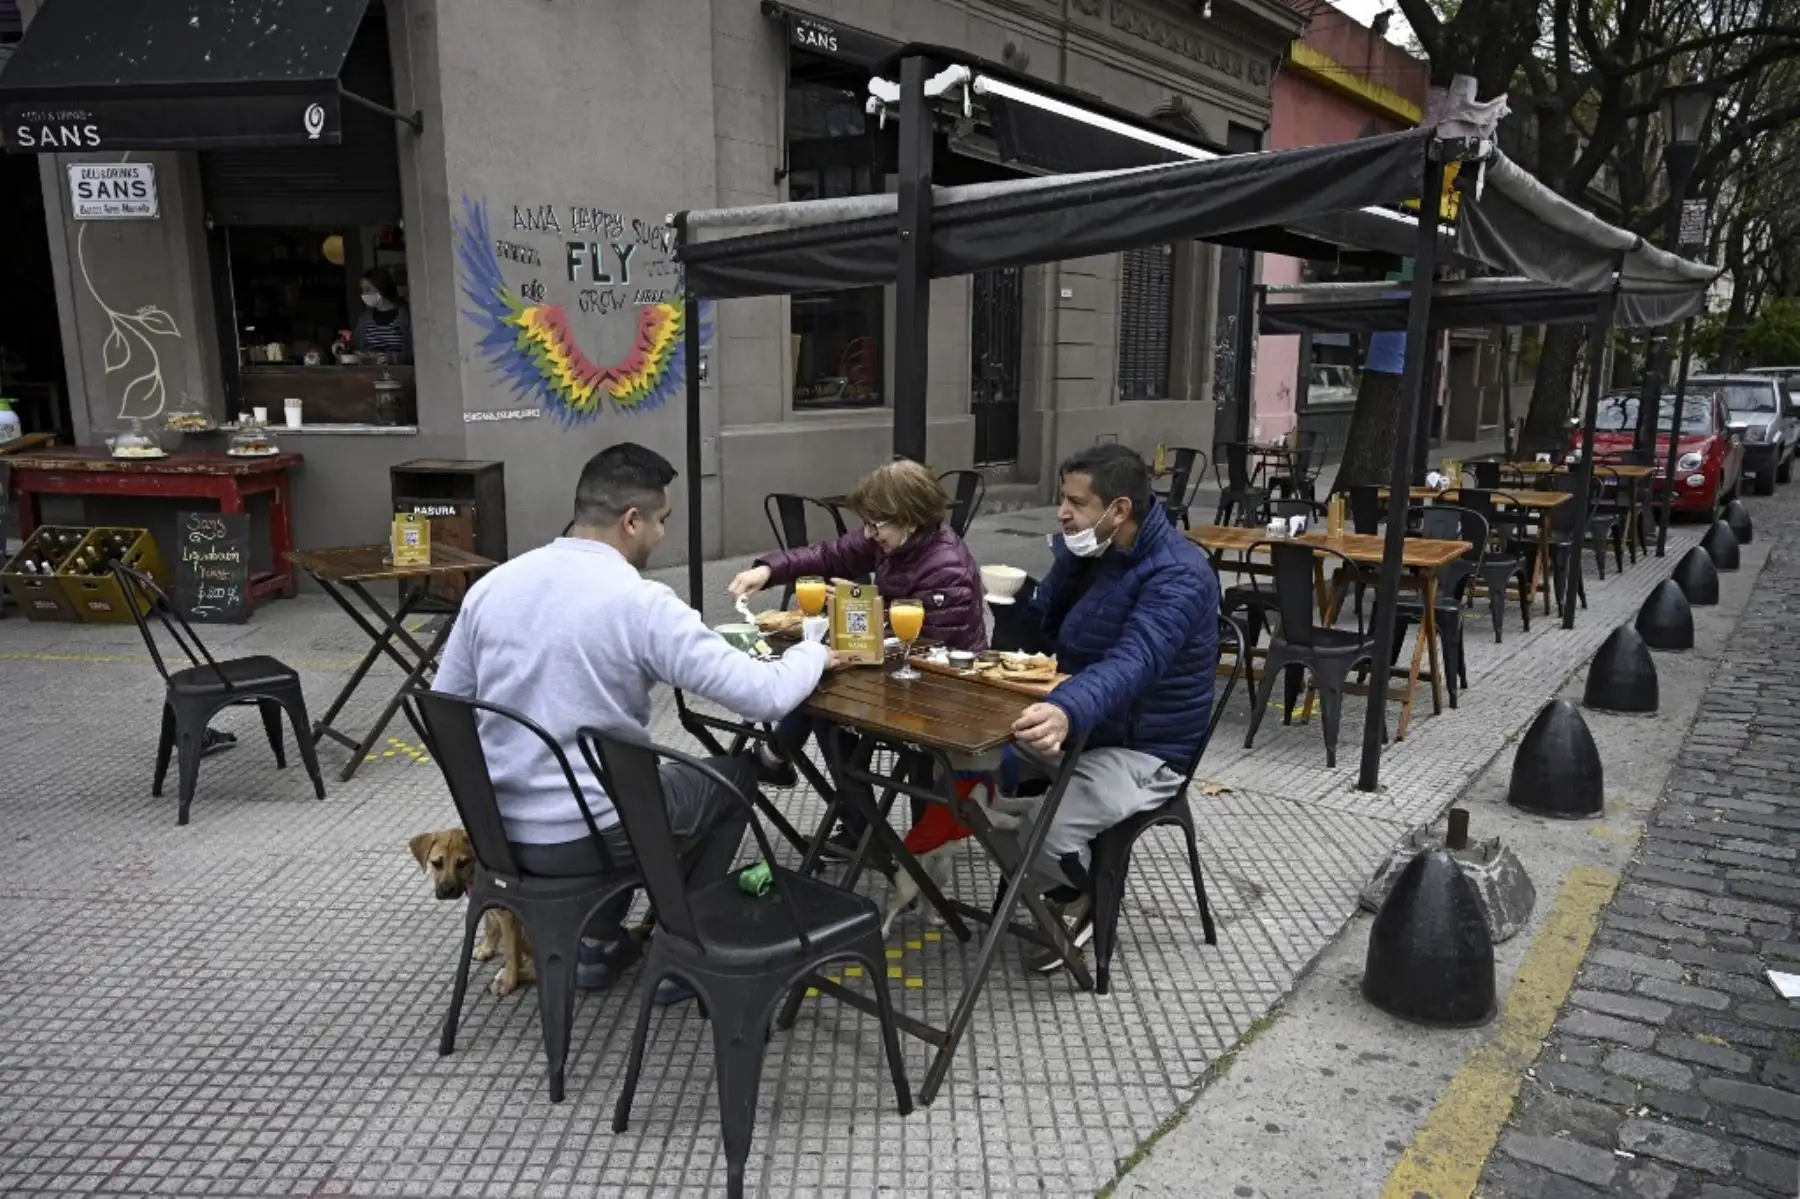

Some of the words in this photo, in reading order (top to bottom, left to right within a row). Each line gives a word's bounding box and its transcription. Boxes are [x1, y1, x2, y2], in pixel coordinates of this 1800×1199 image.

[796, 26, 838, 52] SANS
[17, 125, 101, 147] SANS
[78, 180, 147, 199] SANS
[566, 241, 637, 285] FLY
[579, 289, 626, 315] GROW
